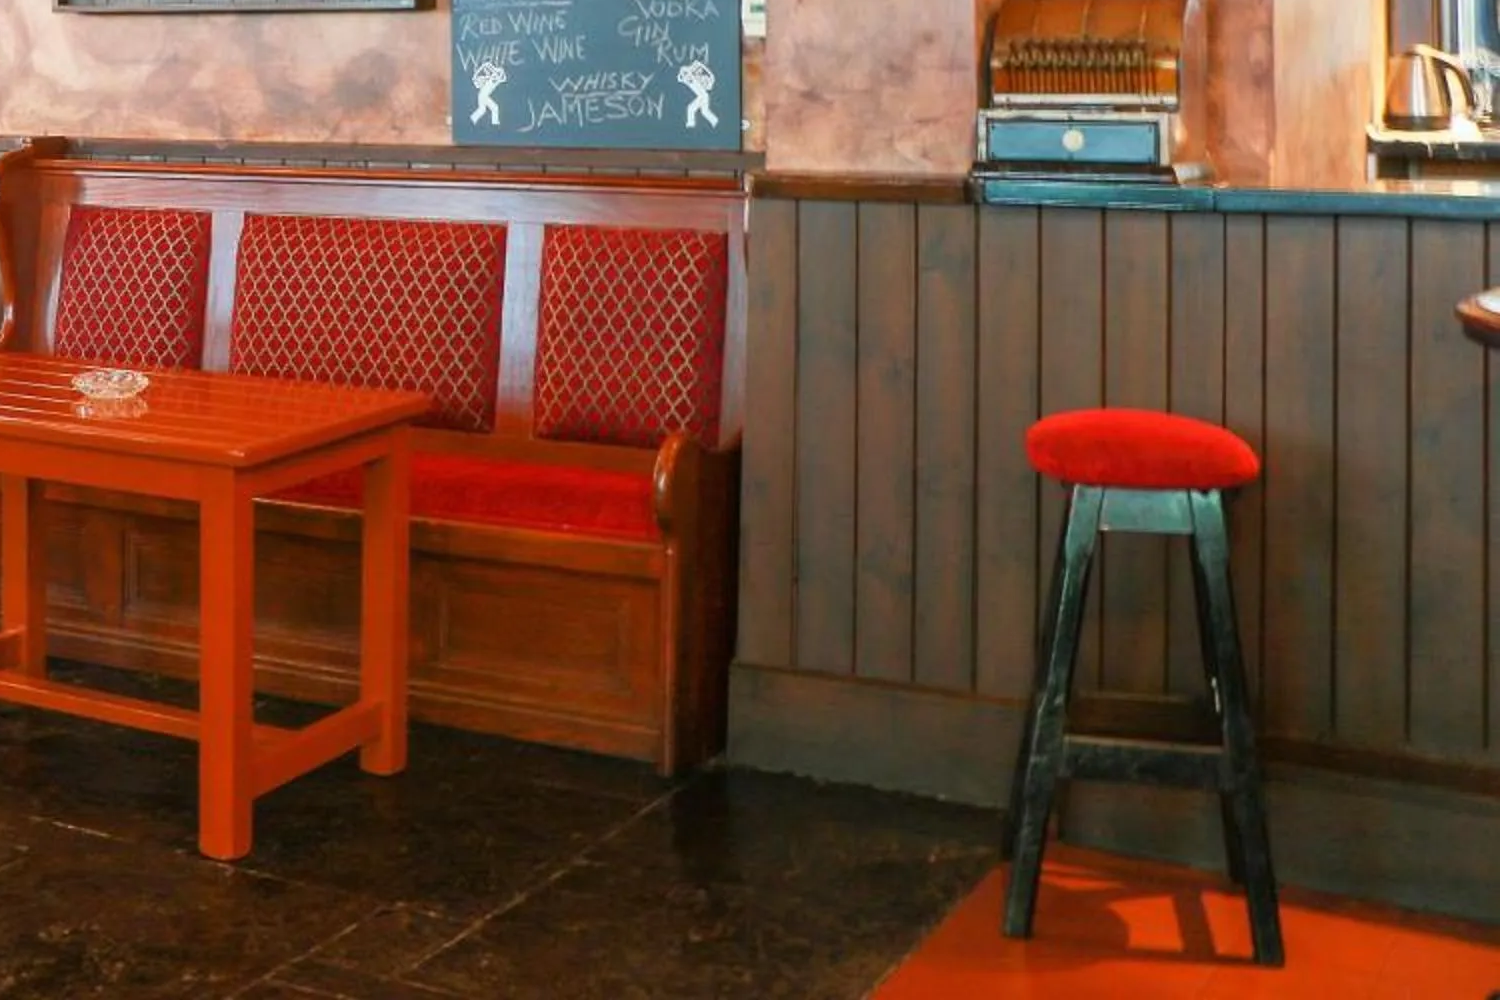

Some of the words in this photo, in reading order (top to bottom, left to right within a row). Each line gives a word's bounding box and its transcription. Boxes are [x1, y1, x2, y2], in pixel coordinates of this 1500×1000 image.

[458, 12, 502, 42] RED
[507, 9, 568, 36] WINE
[617, 15, 669, 47] GIN
[455, 39, 525, 72] WHITE
[531, 34, 587, 64] WINE
[656, 41, 710, 67] RUM
[548, 70, 655, 93] WHISKY
[516, 92, 666, 134] JAMESON
